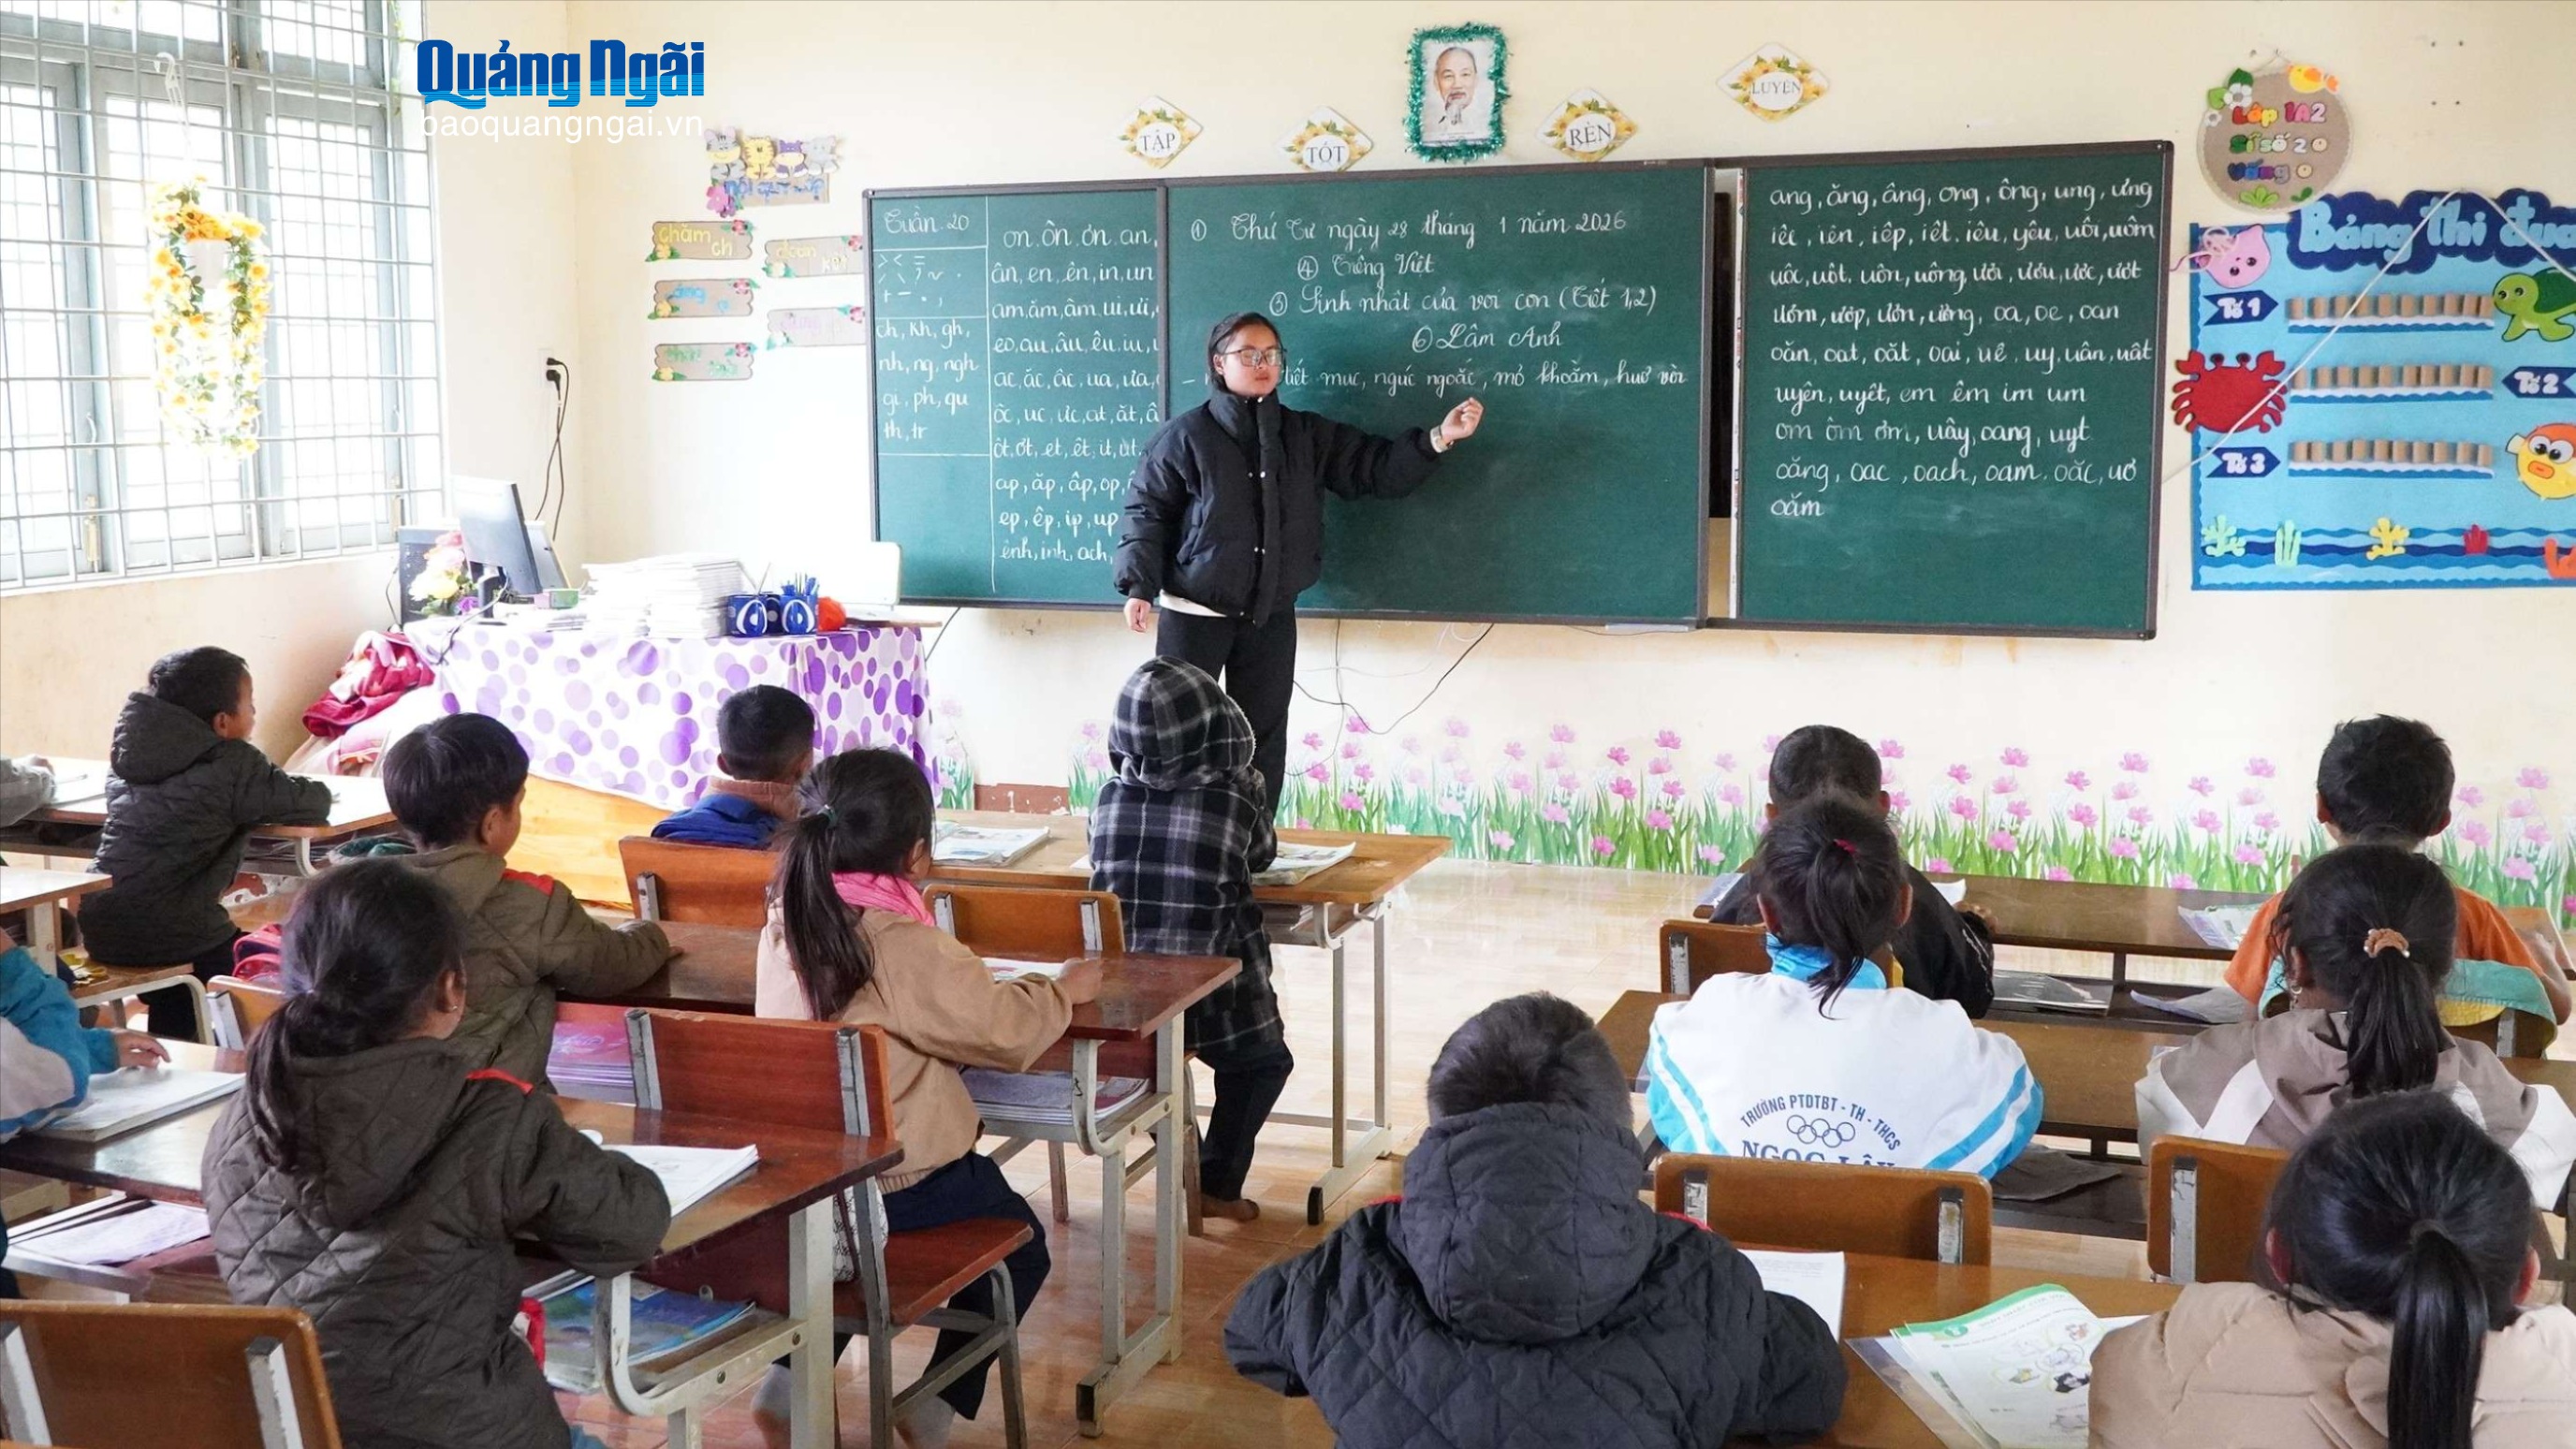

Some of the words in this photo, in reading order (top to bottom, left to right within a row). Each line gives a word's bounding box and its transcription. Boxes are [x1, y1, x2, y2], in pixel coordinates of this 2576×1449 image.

[659, 224, 711, 242] chăm
[947, 212, 969, 230] 20
[1232, 212, 1277, 240] Thứ
[1330, 218, 1379, 251] ngày
[1387, 221, 1407, 239] 28
[1422, 210, 1475, 249] tháng
[1500, 217, 1506, 233] 1
[1517, 211, 1570, 234] năm
[1575, 211, 1626, 231] 2026
[2299, 200, 2413, 264] Bảng
[1395, 251, 1434, 277] Việt
[1422, 286, 1458, 312] của
[1515, 294, 1550, 308] con
[2247, 298, 2260, 316] 1
[2080, 305, 2118, 320] oan
[1436, 324, 1496, 348] Lâm
[1509, 321, 1562, 347] Anh
[944, 352, 979, 382] ngh
[1900, 387, 1936, 402] em
[1951, 380, 1989, 403] êm
[2003, 383, 2033, 402] im
[2048, 387, 2086, 402] um
[2542, 373, 2558, 394] 2
[944, 392, 969, 416] qu
[912, 422, 928, 439] tr
[1776, 423, 1813, 440] om
[2050, 416, 2091, 453] uyt
[2250, 453, 2264, 474] 3
[1771, 491, 1824, 517] oăm
[1094, 513, 1119, 536] up
[1740, 1096, 1786, 1128] TRƯỜNG
[1790, 1094, 1837, 1111] PTDTBT
[1850, 1104, 1866, 1121] TH
[1874, 1120, 1900, 1150] THCS
